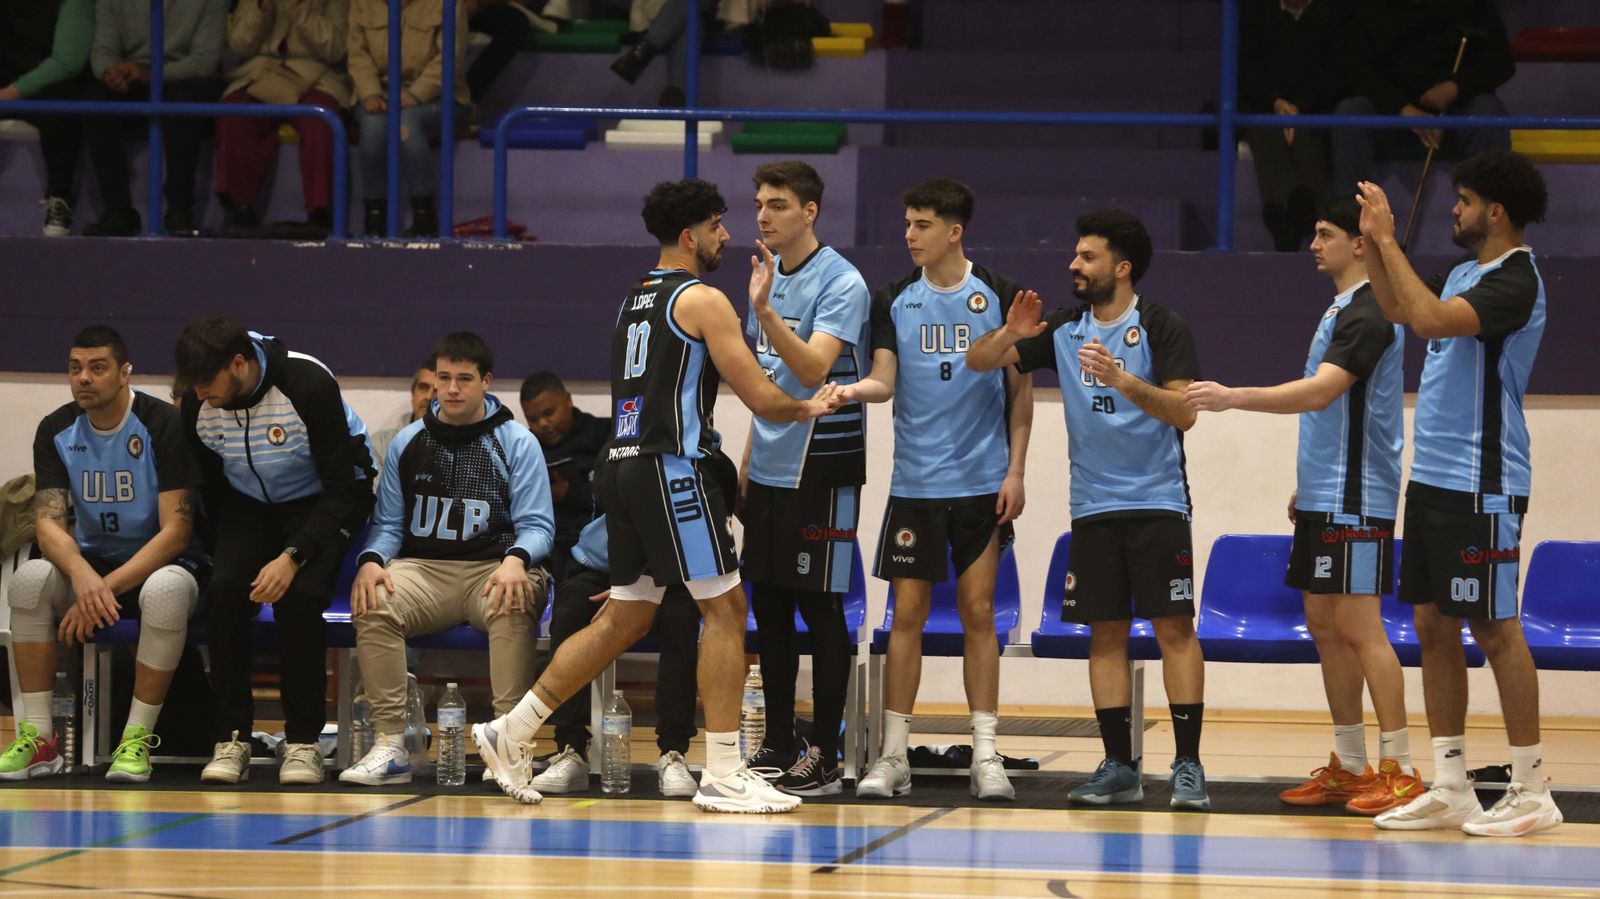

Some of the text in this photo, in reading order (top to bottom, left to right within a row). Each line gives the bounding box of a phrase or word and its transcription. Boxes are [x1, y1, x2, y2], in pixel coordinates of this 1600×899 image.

[624, 320, 651, 379] 10
[920, 324, 971, 354] ULB
[940, 361, 952, 381] 8
[1092, 395, 1116, 414] 20
[82, 470, 135, 503] ULB
[669, 476, 702, 523] ULB
[100, 512, 119, 533] 13
[410, 494, 490, 541] ULB
[797, 552, 810, 574] 9
[892, 555, 915, 564] vive
[1314, 556, 1333, 578] 12
[1169, 579, 1193, 601] 20
[1450, 577, 1479, 602] 00
